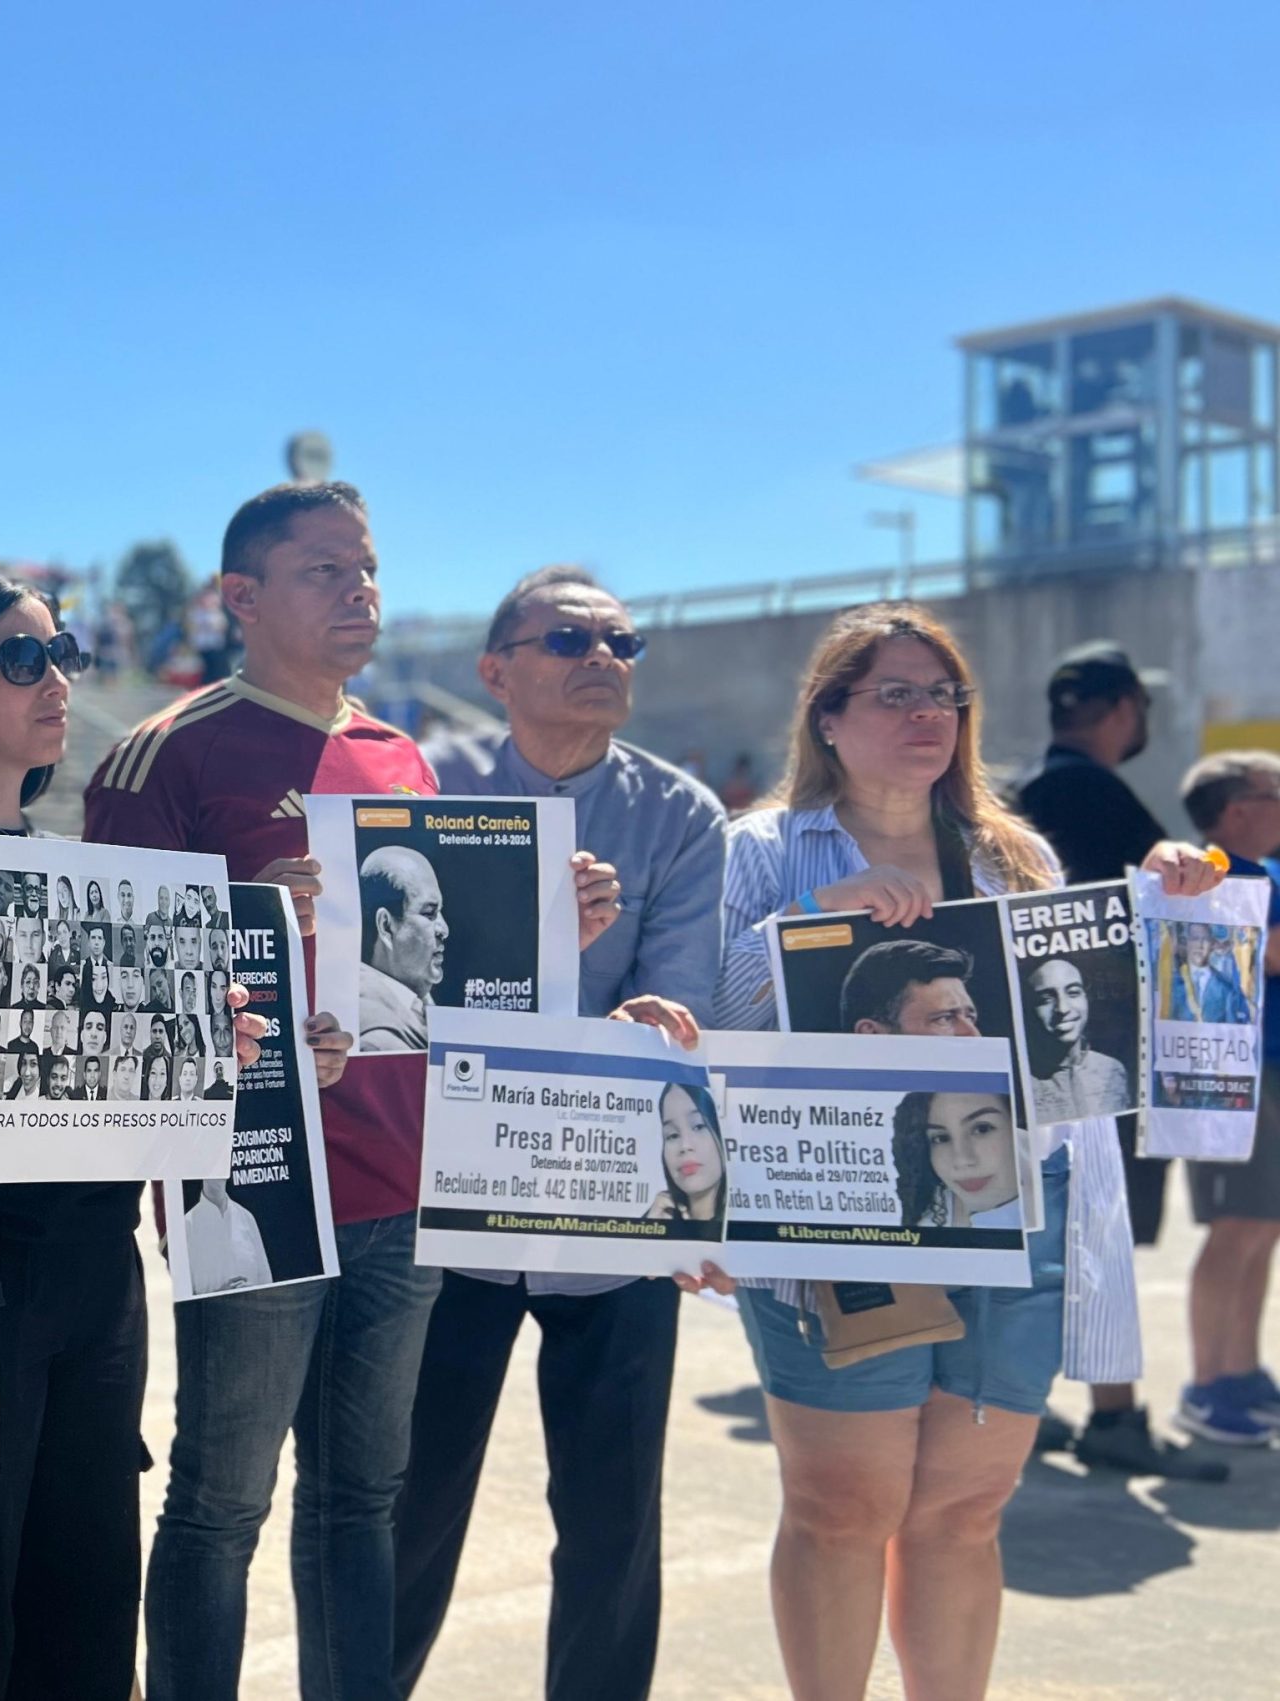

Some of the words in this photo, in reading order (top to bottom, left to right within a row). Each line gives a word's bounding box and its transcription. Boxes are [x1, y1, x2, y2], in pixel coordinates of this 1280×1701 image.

[425, 815, 474, 830] Roland
[478, 815, 530, 831] Carreño
[439, 834, 481, 845] Detenido
[484, 834, 492, 845] el
[1011, 899, 1096, 932] EREN
[1104, 896, 1126, 920] A
[236, 971, 278, 984] DERECHOS
[464, 977, 532, 996] #Roland
[464, 995, 532, 1010] DebeEstar
[1162, 1035, 1249, 1061] LIBERTAD
[492, 1084, 535, 1105] María
[541, 1088, 600, 1110] Gabriela
[606, 1092, 653, 1115] Campo
[20, 1113, 69, 1127] TODOS
[72, 1113, 99, 1127] LOS
[104, 1113, 156, 1127] PRESOS
[160, 1110, 227, 1127] POLÍTICOS
[739, 1104, 802, 1130] Wendy
[810, 1106, 884, 1127] Milanéz
[232, 1129, 277, 1147] EXIGIMOS
[278, 1128, 292, 1142] SU
[495, 1123, 552, 1151] Presa
[562, 1127, 636, 1155] Política
[231, 1145, 283, 1166] APARICIÓN
[724, 1138, 788, 1163] Presa
[798, 1140, 885, 1166] Política
[531, 1155, 572, 1170] Detenida
[574, 1159, 582, 1171] el
[585, 1159, 638, 1174] 30/07/2024
[232, 1165, 290, 1186] INMEDIATA!
[767, 1168, 813, 1182] Detenida
[815, 1169, 825, 1182] el
[827, 1170, 889, 1184] 29/07/2024
[435, 1170, 487, 1195] Recluida
[492, 1180, 506, 1196] en
[511, 1176, 540, 1198] Dest.
[545, 1178, 566, 1199] 442
[570, 1179, 632, 1203] GNB-YARE
[728, 1187, 750, 1209] ida
[755, 1192, 770, 1210] en
[775, 1189, 814, 1211] Retén
[819, 1191, 833, 1211] La
[838, 1190, 896, 1213] Crisálida
[486, 1213, 666, 1235] #LiberenAMariaGabriela
[777, 1225, 920, 1245] #LiberenAWendy
